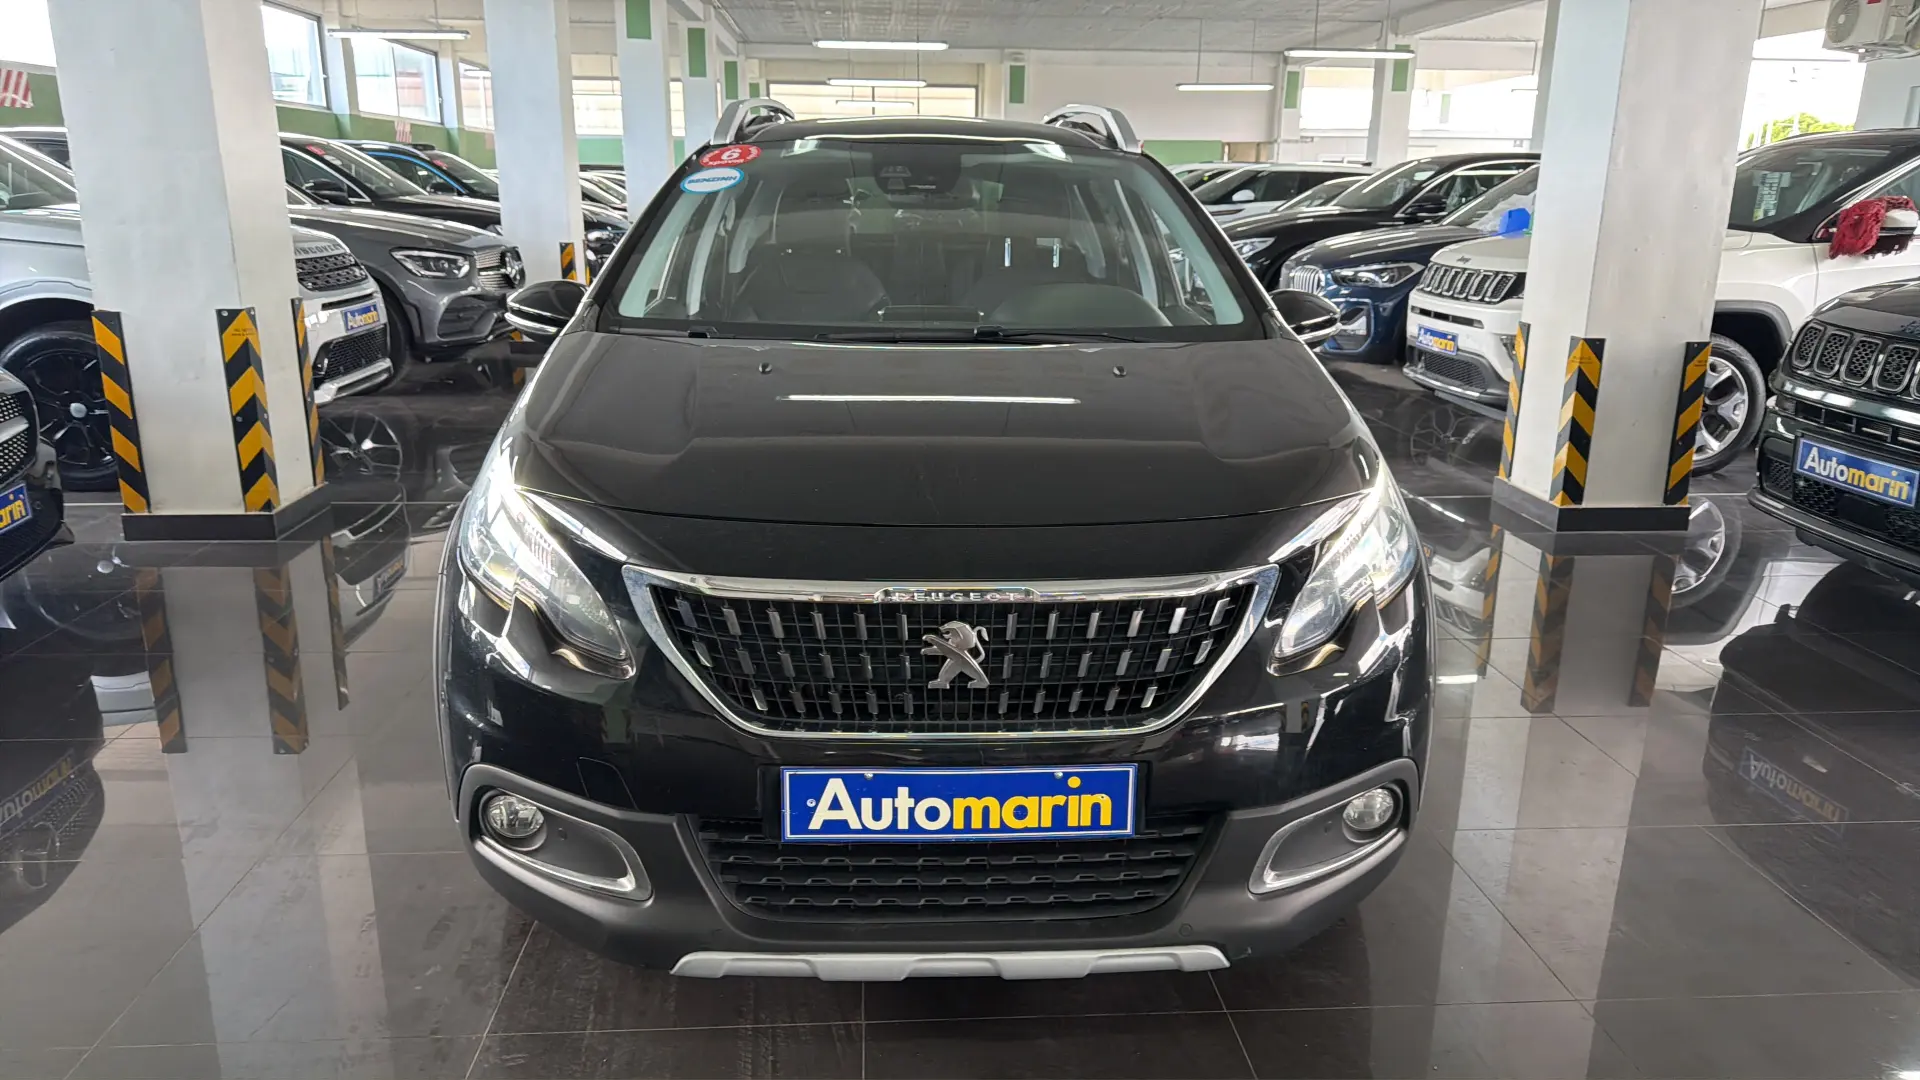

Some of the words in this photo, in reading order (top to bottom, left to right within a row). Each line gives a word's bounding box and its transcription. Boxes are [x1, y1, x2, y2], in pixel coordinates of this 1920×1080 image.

[721, 148, 742, 160] 6
[1803, 446, 1909, 500] Automarin
[894, 592, 1019, 601] PEUGEOT
[808, 776, 1112, 830] Automarin
